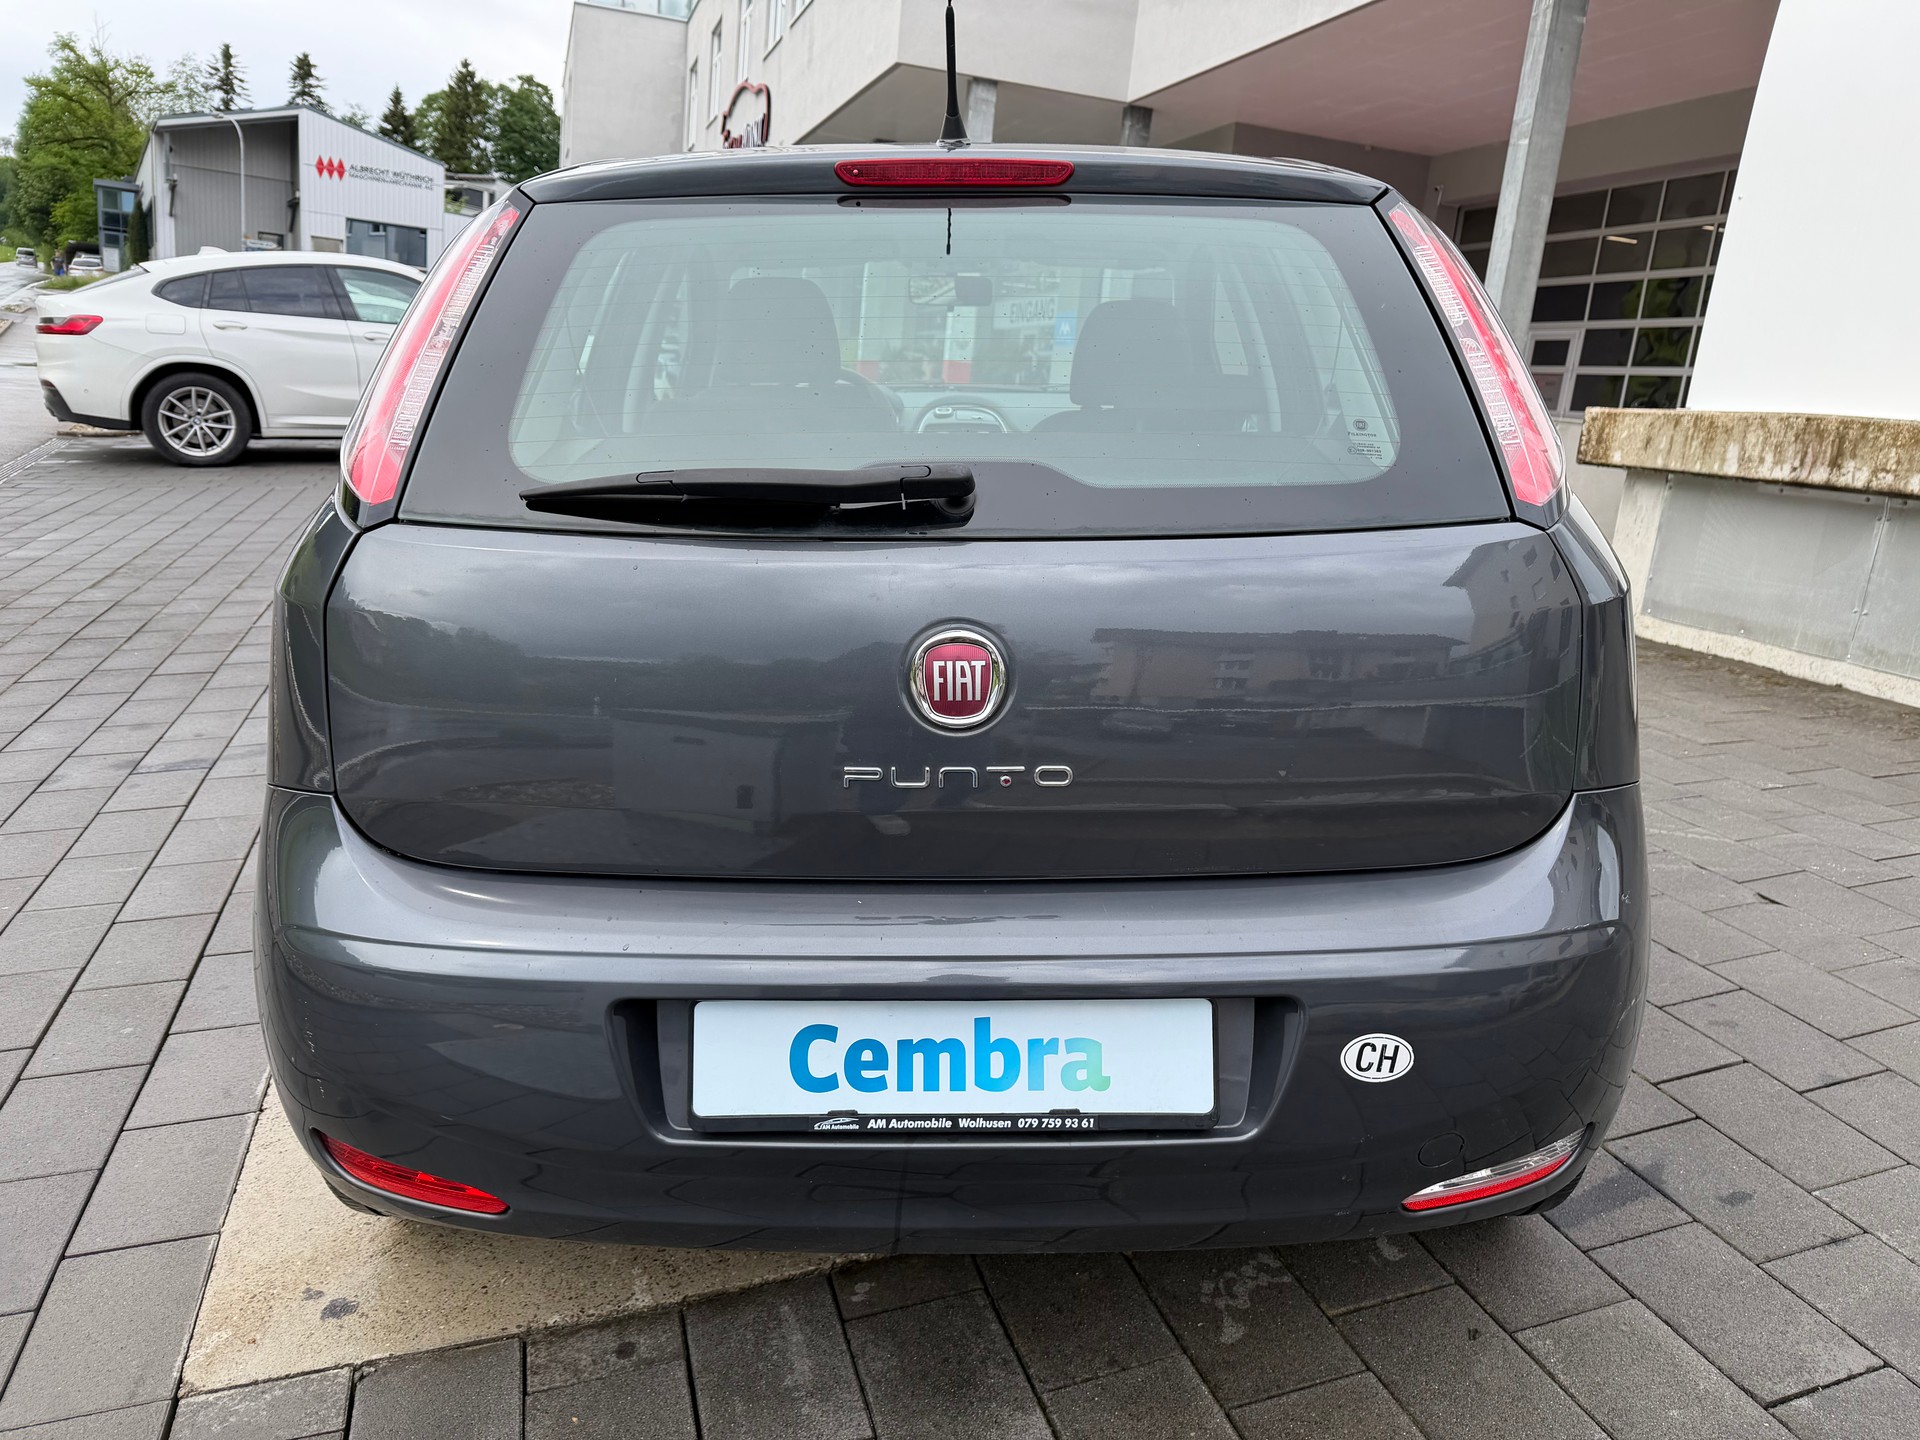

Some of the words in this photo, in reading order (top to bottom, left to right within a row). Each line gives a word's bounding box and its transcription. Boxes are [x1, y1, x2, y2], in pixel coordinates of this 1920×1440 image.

[349, 164, 389, 175] ALBRECHT
[1009, 298, 1056, 324] EINGANG
[932, 660, 986, 701] FIAT
[843, 765, 1074, 788] PUNTO
[788, 1016, 1111, 1094] Cembra
[1356, 1041, 1400, 1073] CH
[867, 1118, 886, 1129] AM
[889, 1117, 953, 1129] Automobile
[958, 1117, 1012, 1129] Wolhusen
[1017, 1118, 1039, 1129] 079
[1041, 1118, 1063, 1129] 759
[1064, 1118, 1079, 1129] 93
[1081, 1118, 1095, 1129] 61
